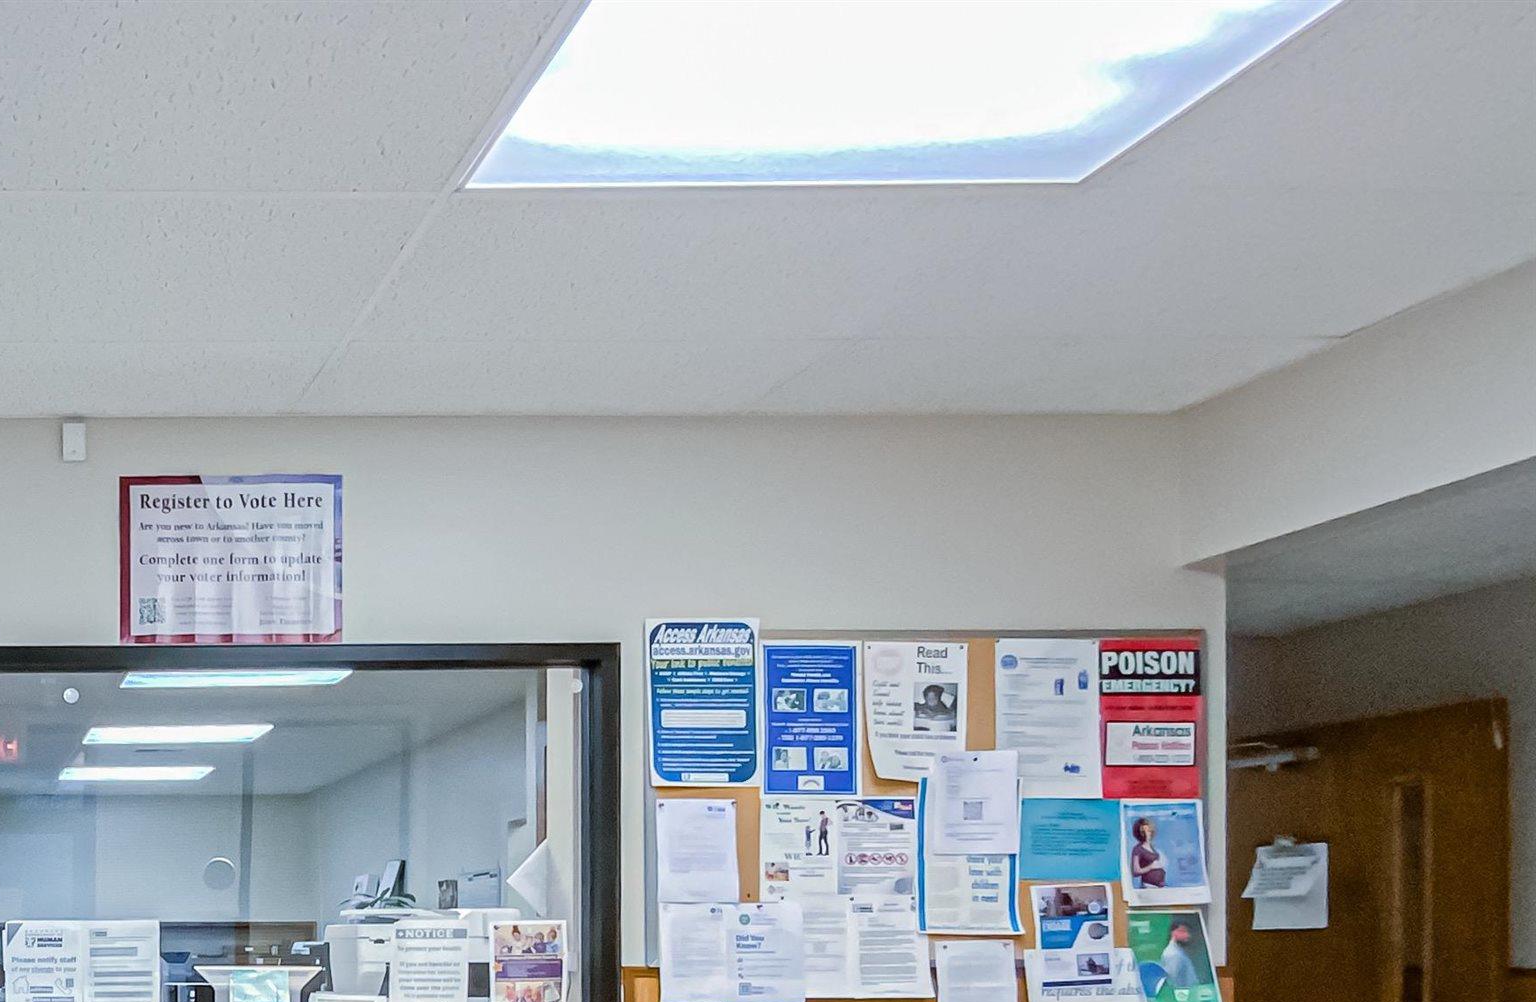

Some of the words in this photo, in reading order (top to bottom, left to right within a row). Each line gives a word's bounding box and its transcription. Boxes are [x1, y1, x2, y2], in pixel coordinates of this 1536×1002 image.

[139, 493, 210, 514] Register
[216, 495, 233, 509] to
[239, 493, 277, 508] Vote
[283, 492, 324, 508] Here
[139, 522, 153, 531] Are
[156, 523, 172, 532] you
[195, 523, 204, 531] to
[251, 522, 274, 530] Have
[186, 535, 209, 543] town
[211, 535, 221, 543] or
[223, 535, 233, 543] to
[234, 534, 270, 543] another
[139, 553, 199, 568] Complete
[202, 556, 225, 566] one
[229, 552, 259, 566] form
[263, 554, 276, 565] to
[280, 553, 322, 567] update
[157, 573, 186, 586] your
[189, 571, 223, 583] voter
[226, 570, 306, 583] information!
[653, 624, 698, 644] Access
[695, 623, 751, 644] Arkansas
[652, 645, 751, 658] access.arkansas.gov
[916, 646, 948, 659] Read
[1101, 651, 1195, 675] POISON
[1102, 679, 1196, 693] EMERGENCY
[1132, 725, 1192, 737] Arkansas
[405, 929, 455, 939] NOTICE
